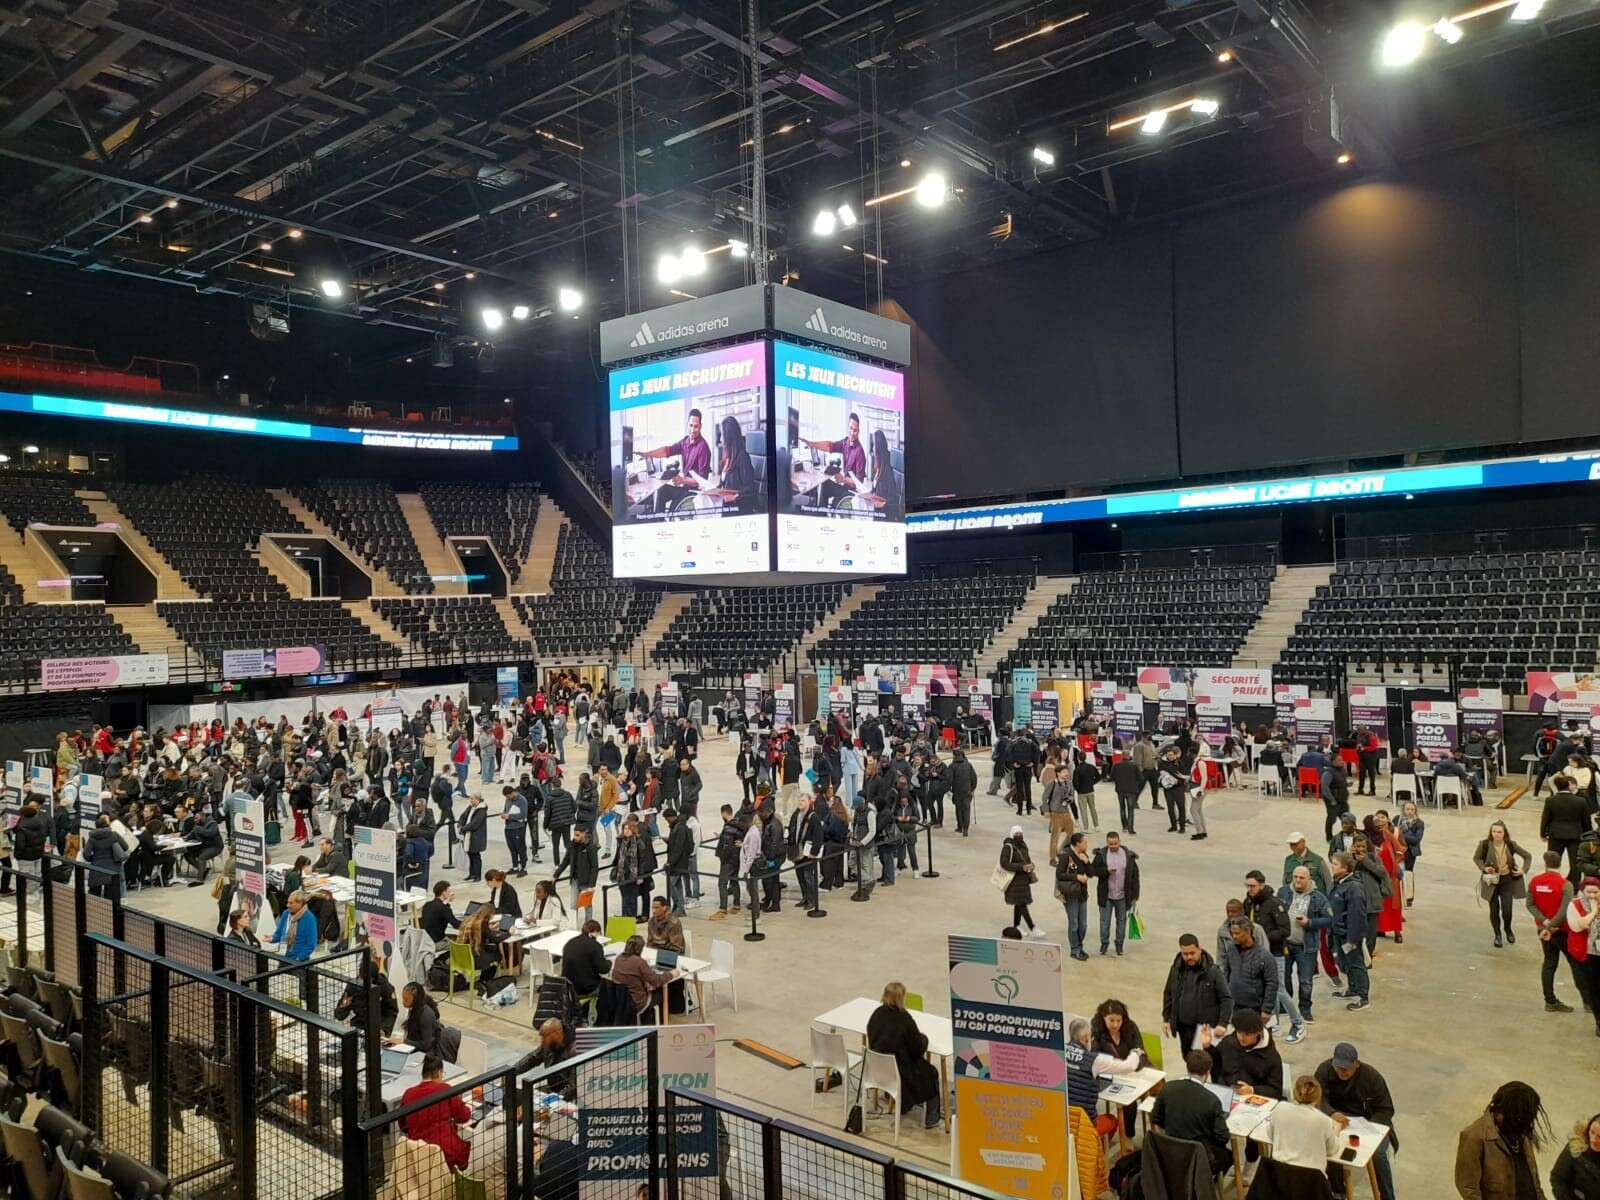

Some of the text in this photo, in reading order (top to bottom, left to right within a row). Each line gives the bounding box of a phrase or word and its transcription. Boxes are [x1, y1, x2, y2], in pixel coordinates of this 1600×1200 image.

[657, 316, 729, 341] adidas arena
[830, 324, 887, 350] adidas arena
[619, 359, 754, 400] LES JEUX RECRUTENT
[785, 360, 897, 400] LES JEUX RECRUTENT
[1211, 673, 1261, 685] SÉCURITÉ
[1232, 685, 1269, 696] PRIVÉE
[1417, 712, 1451, 720] RPS
[1416, 725, 1445, 735] 300
[963, 1010, 984, 1020] 700
[986, 1013, 1062, 1031] OPPORTUNITÉS
[954, 1020, 967, 1028] EN
[968, 1021, 986, 1031] CDI
[987, 1023, 1016, 1036] POUR
[1016, 1027, 1045, 1039] 2024
[587, 1072, 709, 1092] FORMTION
[587, 1115, 632, 1126] TROUVEZ
[606, 1126, 634, 1137] VOUS
[586, 1138, 614, 1149] AVEC
